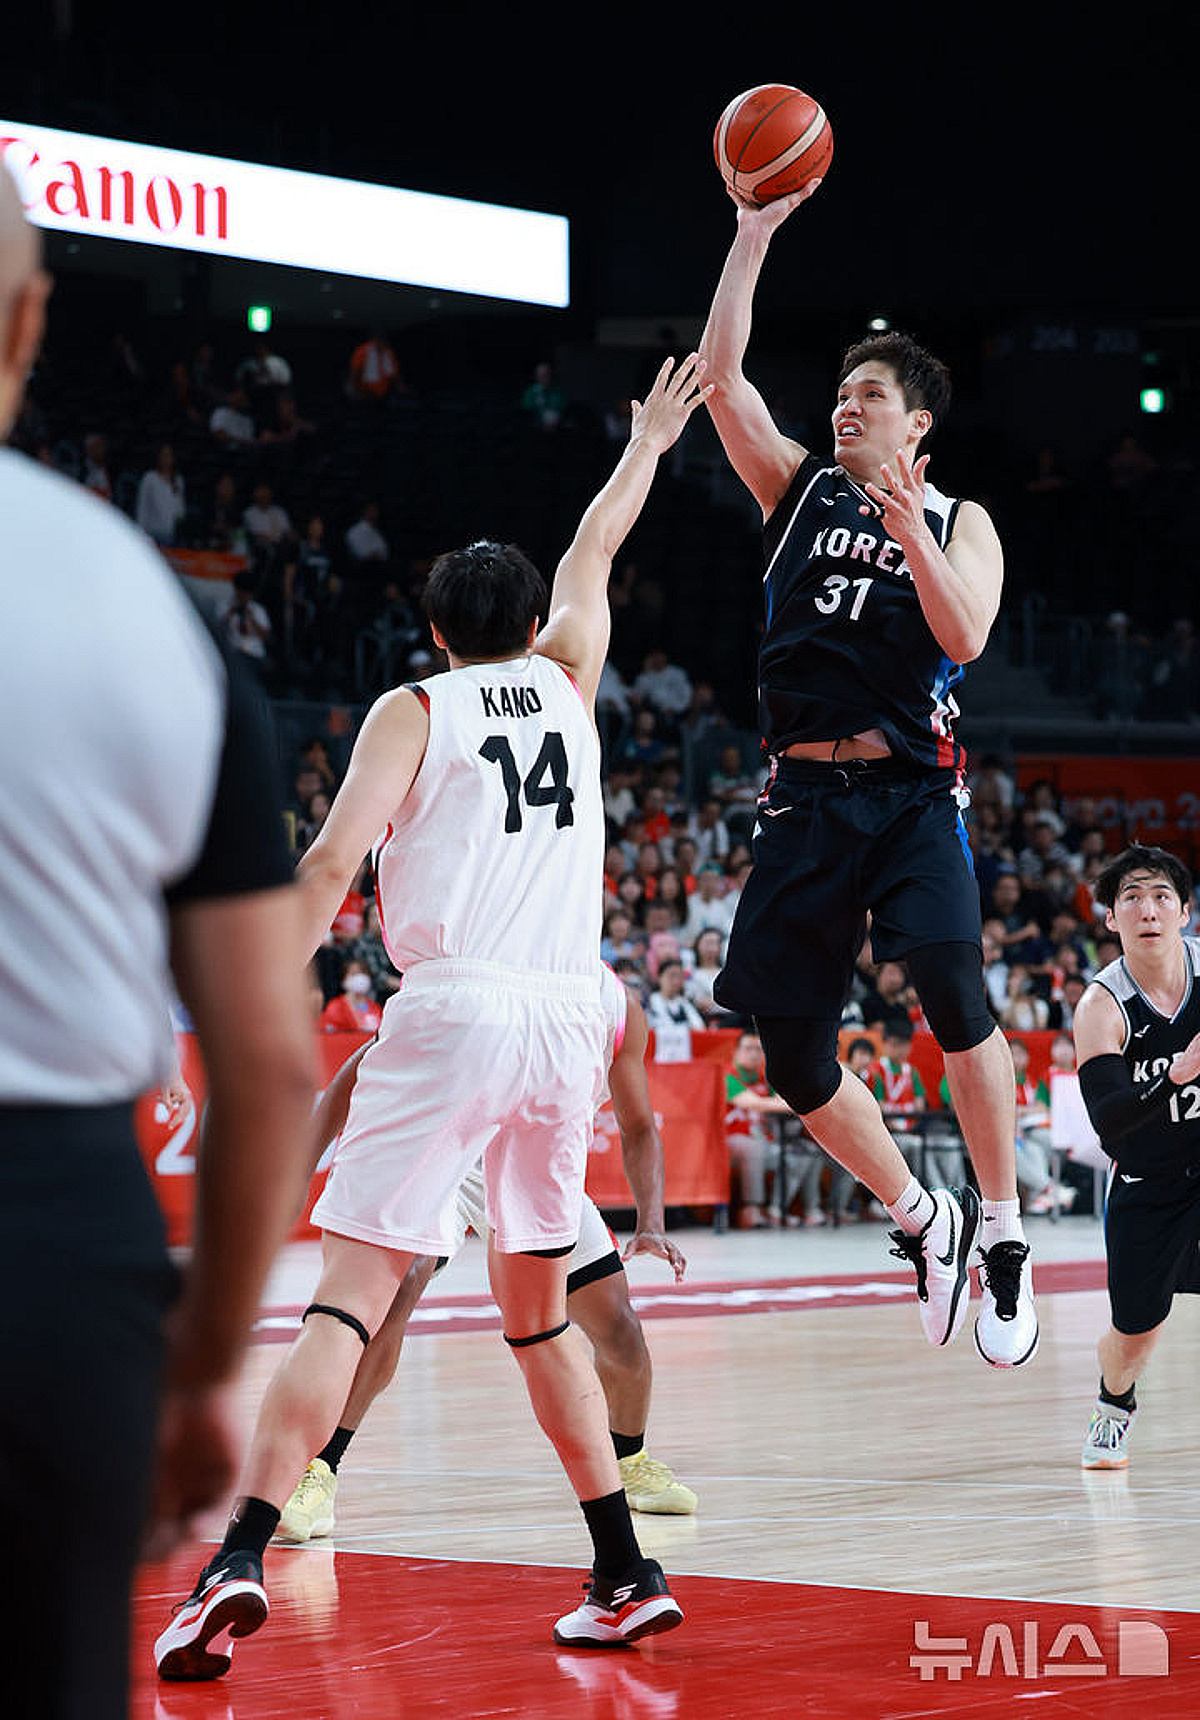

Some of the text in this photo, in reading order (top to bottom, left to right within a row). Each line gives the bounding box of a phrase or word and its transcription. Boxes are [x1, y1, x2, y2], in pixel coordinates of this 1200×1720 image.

[814, 574, 874, 621] 31
[480, 686, 542, 718] KANO
[478, 731, 574, 833] 14
[1169, 1085, 1200, 1122] 12
